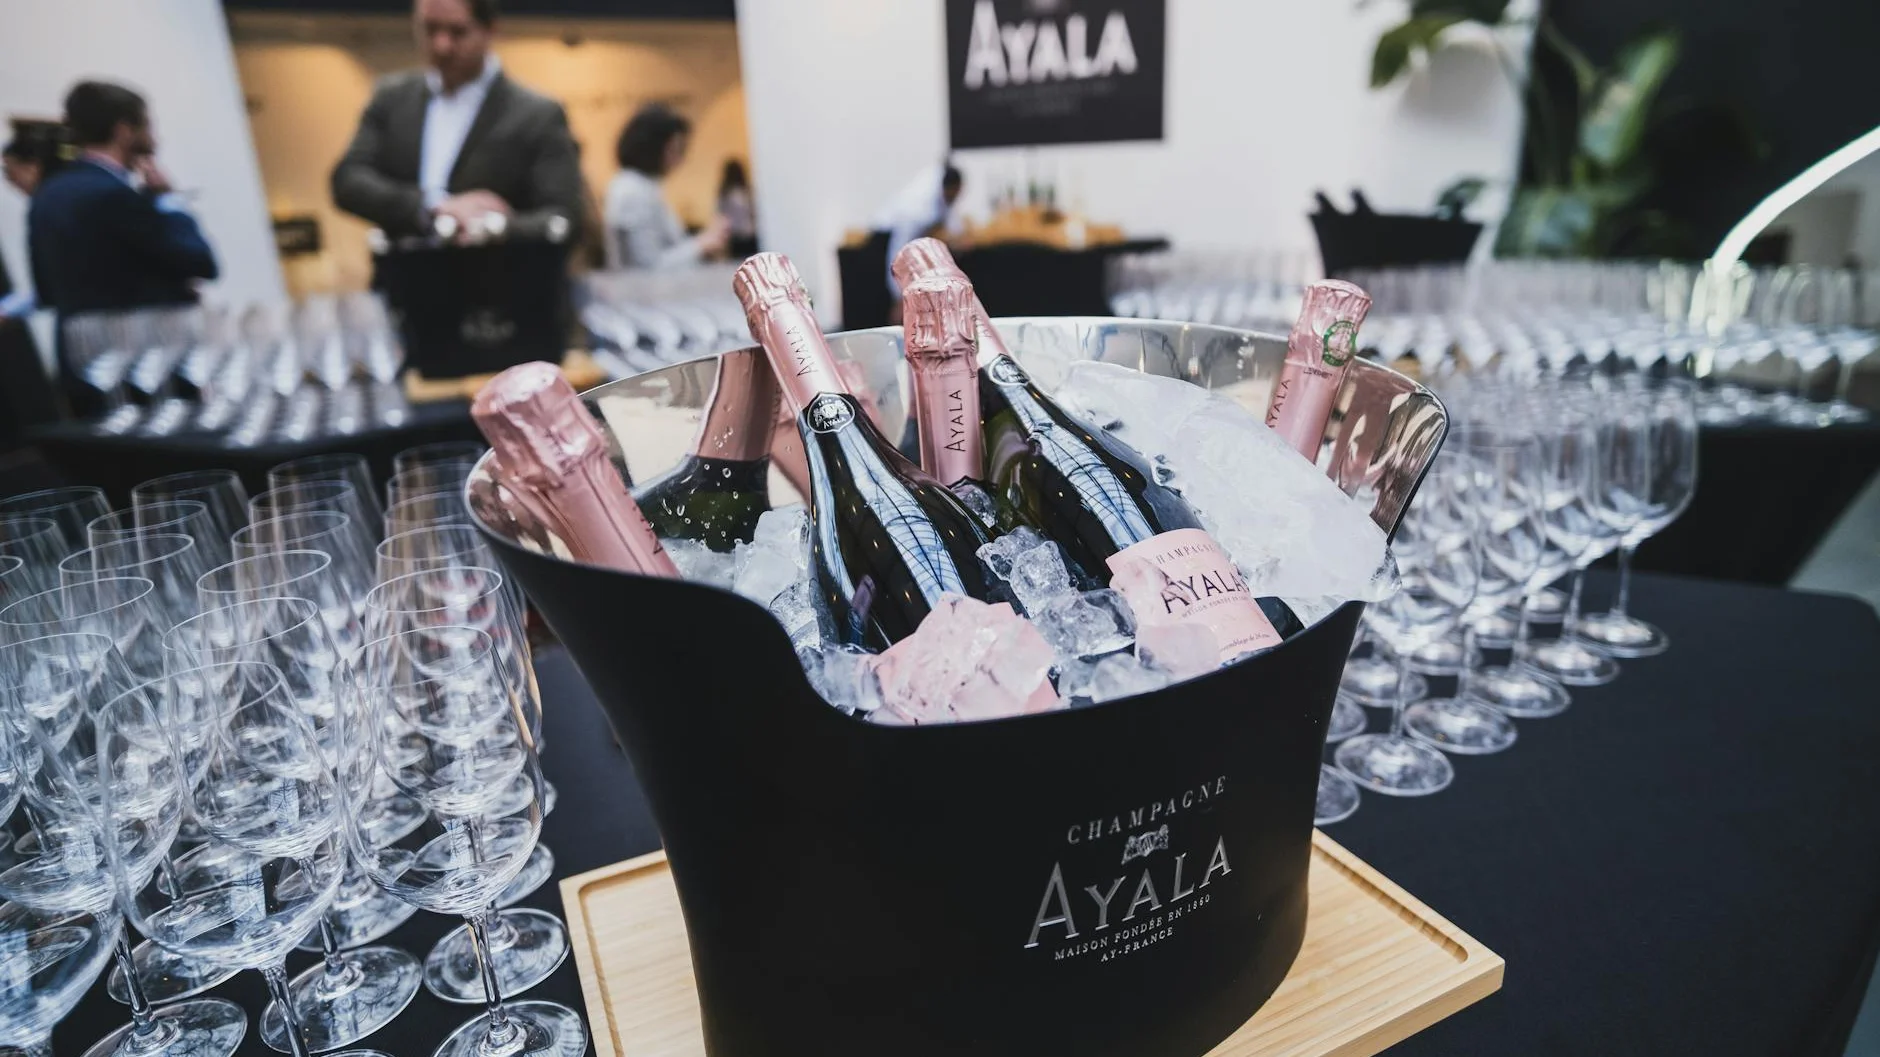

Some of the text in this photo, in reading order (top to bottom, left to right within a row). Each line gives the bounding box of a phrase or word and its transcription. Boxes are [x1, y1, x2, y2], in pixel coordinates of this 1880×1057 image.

[964, 0, 1138, 89] AYALA
[786, 325, 819, 377] AYALA
[944, 389, 966, 452] AYALA
[1067, 775, 1226, 844] CHAMPAGNE
[1024, 835, 1232, 948] AYALA
[1054, 936, 1108, 961] MAISON
[1168, 908, 1182, 922] EN
